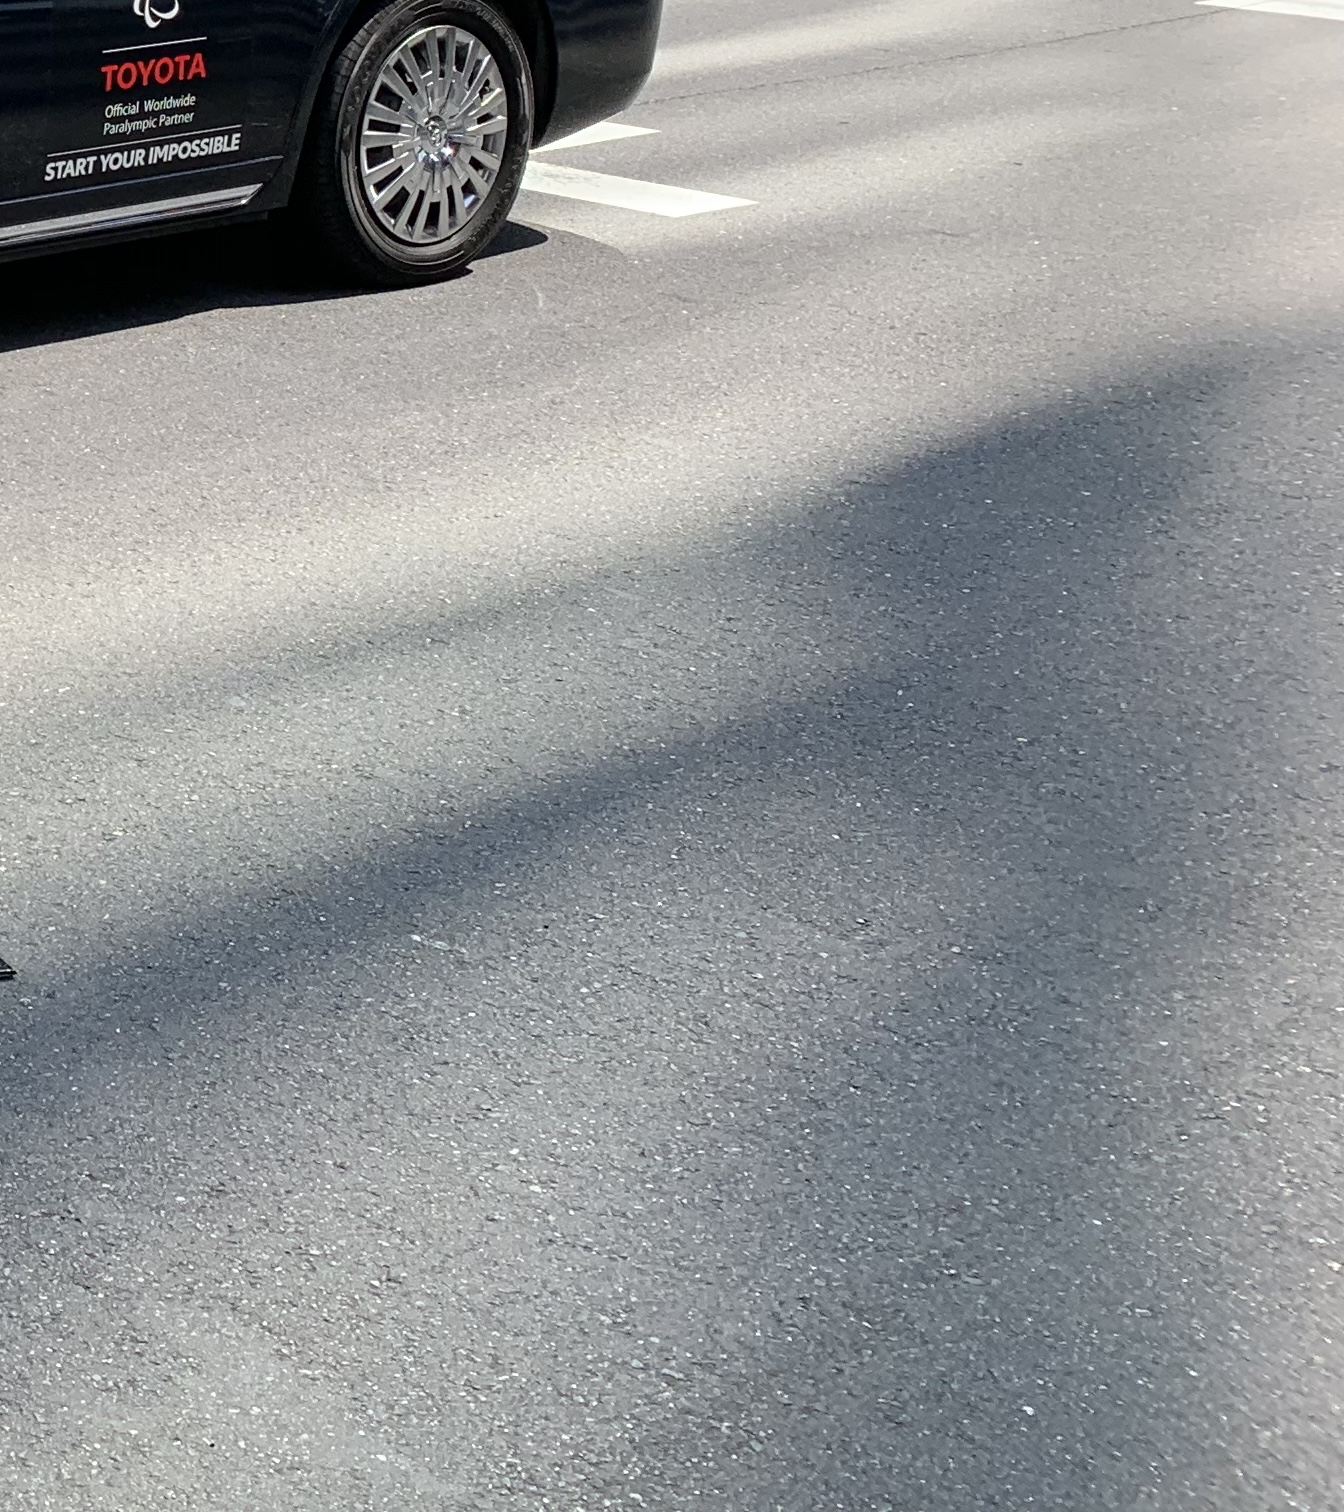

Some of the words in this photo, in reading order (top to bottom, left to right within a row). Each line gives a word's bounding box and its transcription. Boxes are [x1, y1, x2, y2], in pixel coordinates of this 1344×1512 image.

[101, 53, 207, 92] TOYOTA
[104, 102, 139, 119] Official
[144, 94, 196, 112] Worldwide
[103, 115, 157, 136] Paralympic
[159, 111, 194, 127] Partner
[44, 154, 99, 181] START
[100, 148, 146, 172] YOUR
[148, 133, 242, 166] IMPOSSIBLE
